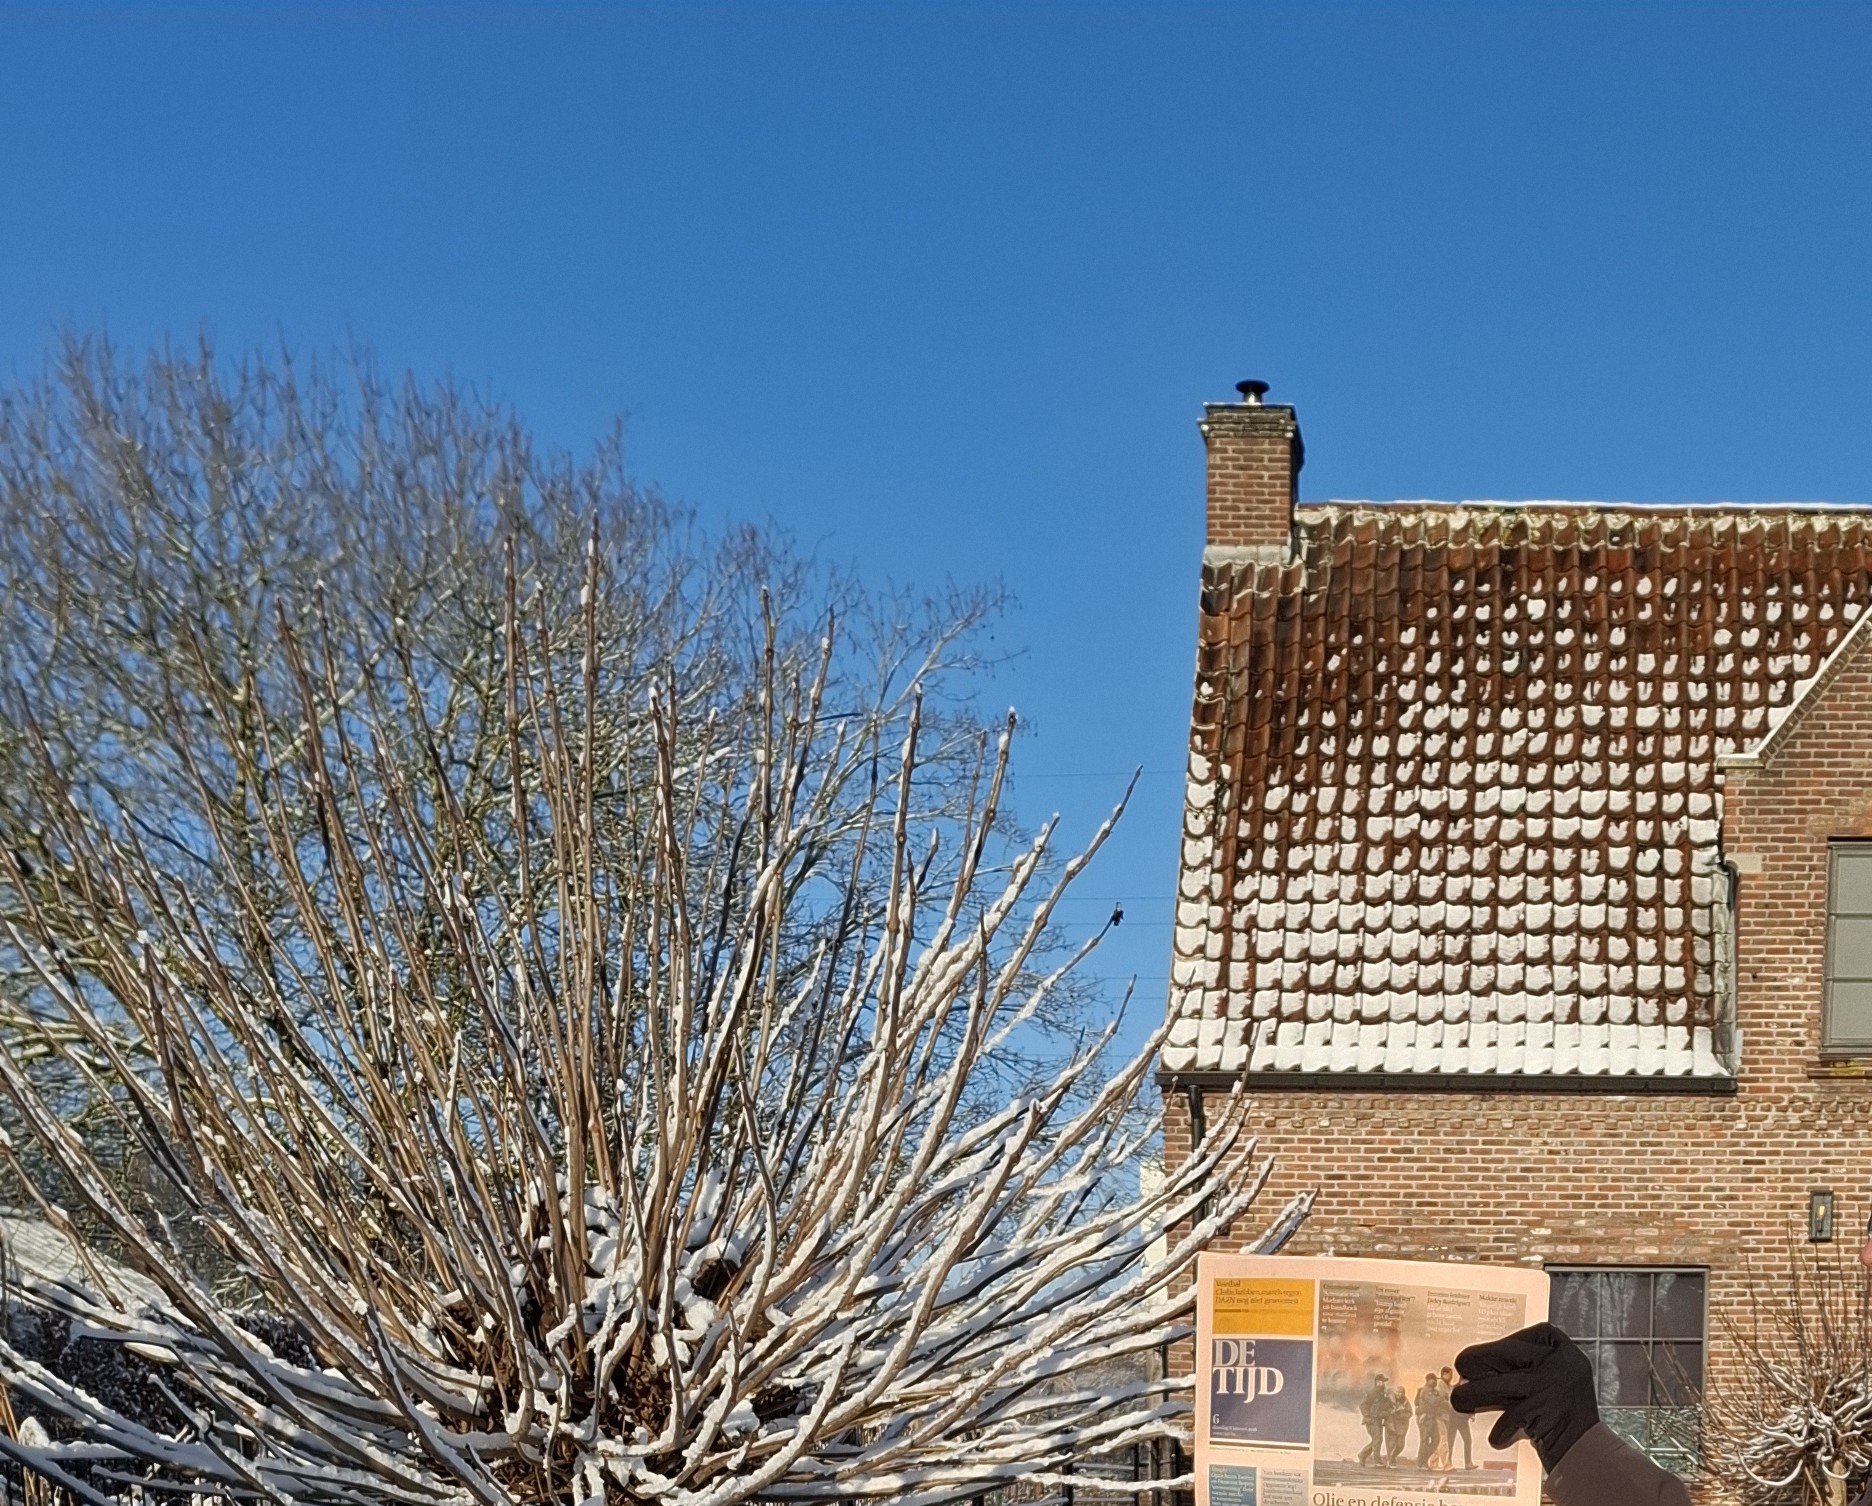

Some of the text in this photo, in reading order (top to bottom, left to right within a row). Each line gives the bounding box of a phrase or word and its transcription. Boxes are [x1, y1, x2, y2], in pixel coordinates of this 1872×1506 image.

[1214, 1340, 1256, 1367] DE
[1212, 1367, 1285, 1404] TIJD
[1212, 1413, 1220, 1425] 6
